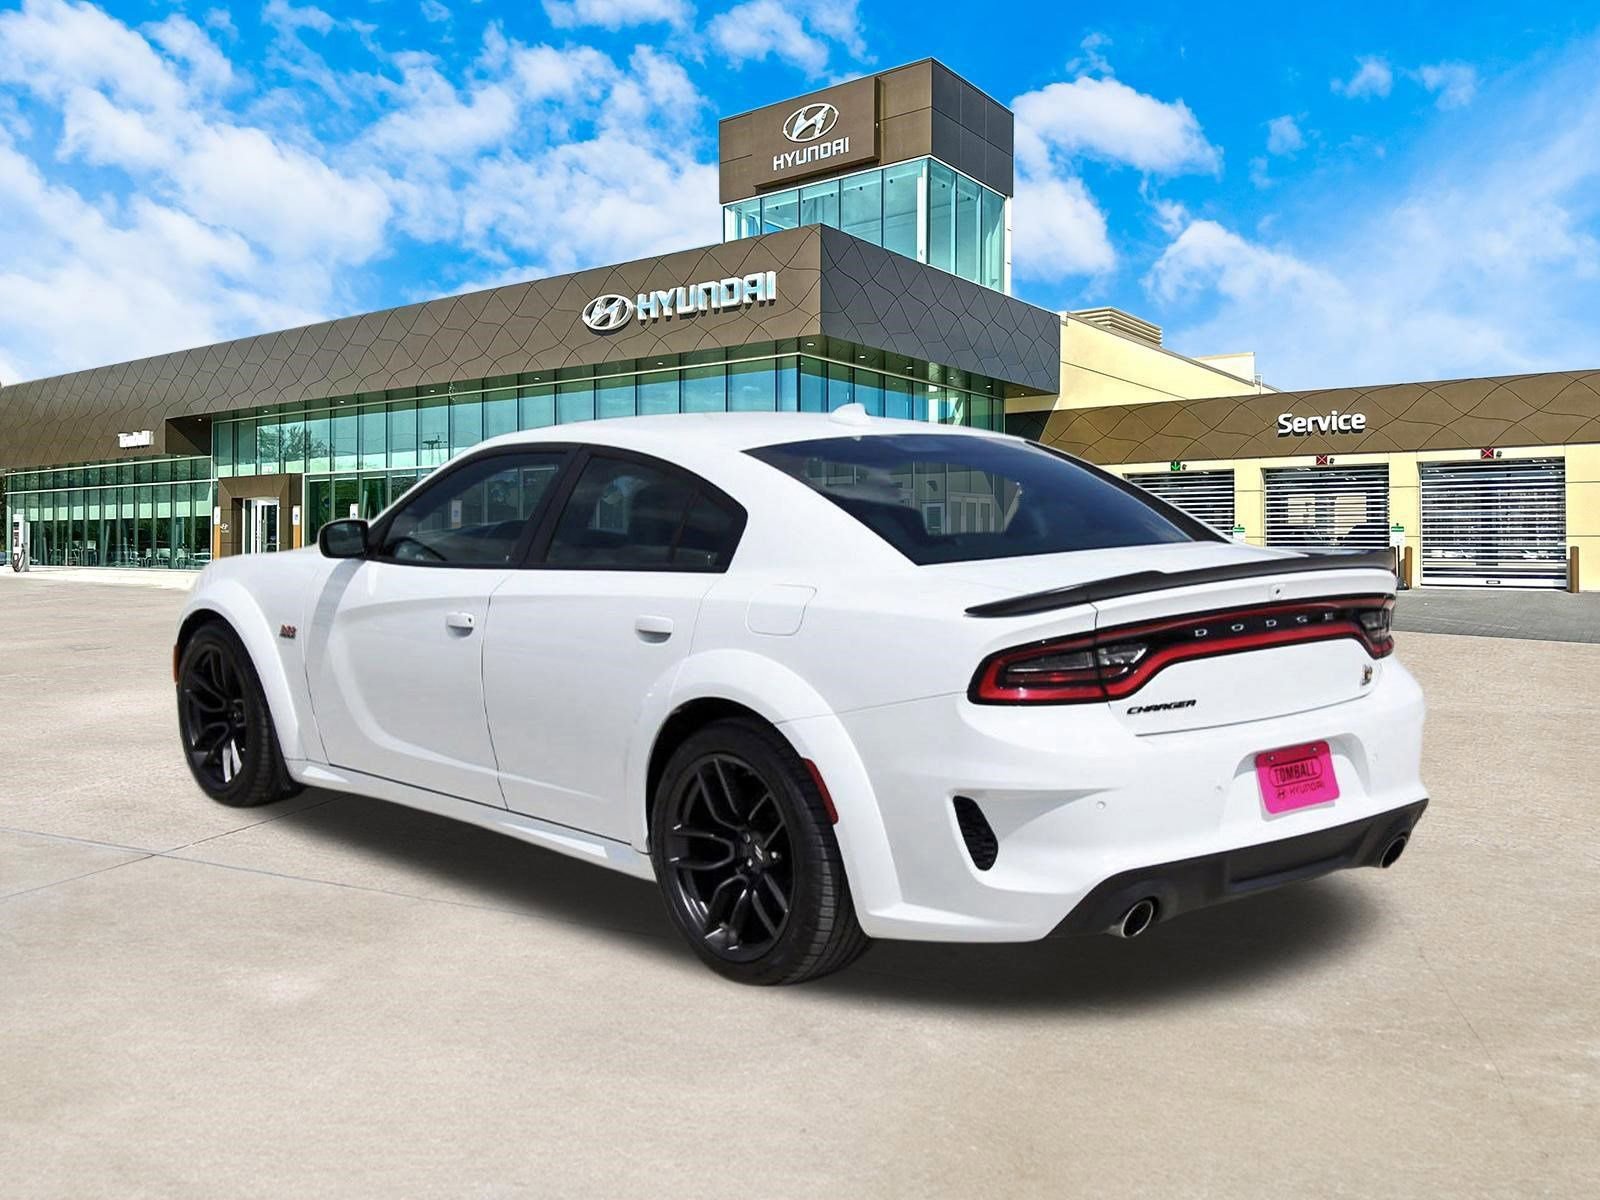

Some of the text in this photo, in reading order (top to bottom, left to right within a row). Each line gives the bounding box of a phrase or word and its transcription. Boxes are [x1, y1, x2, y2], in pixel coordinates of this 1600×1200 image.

[773, 136, 850, 171] HYUNDAI
[636, 271, 777, 321] HYUNDAI
[1277, 410, 1366, 435] Service
[1194, 612, 1334, 637] DODGE
[1126, 699, 1197, 715] CHARGER
[1273, 759, 1318, 785] TOMBALL
